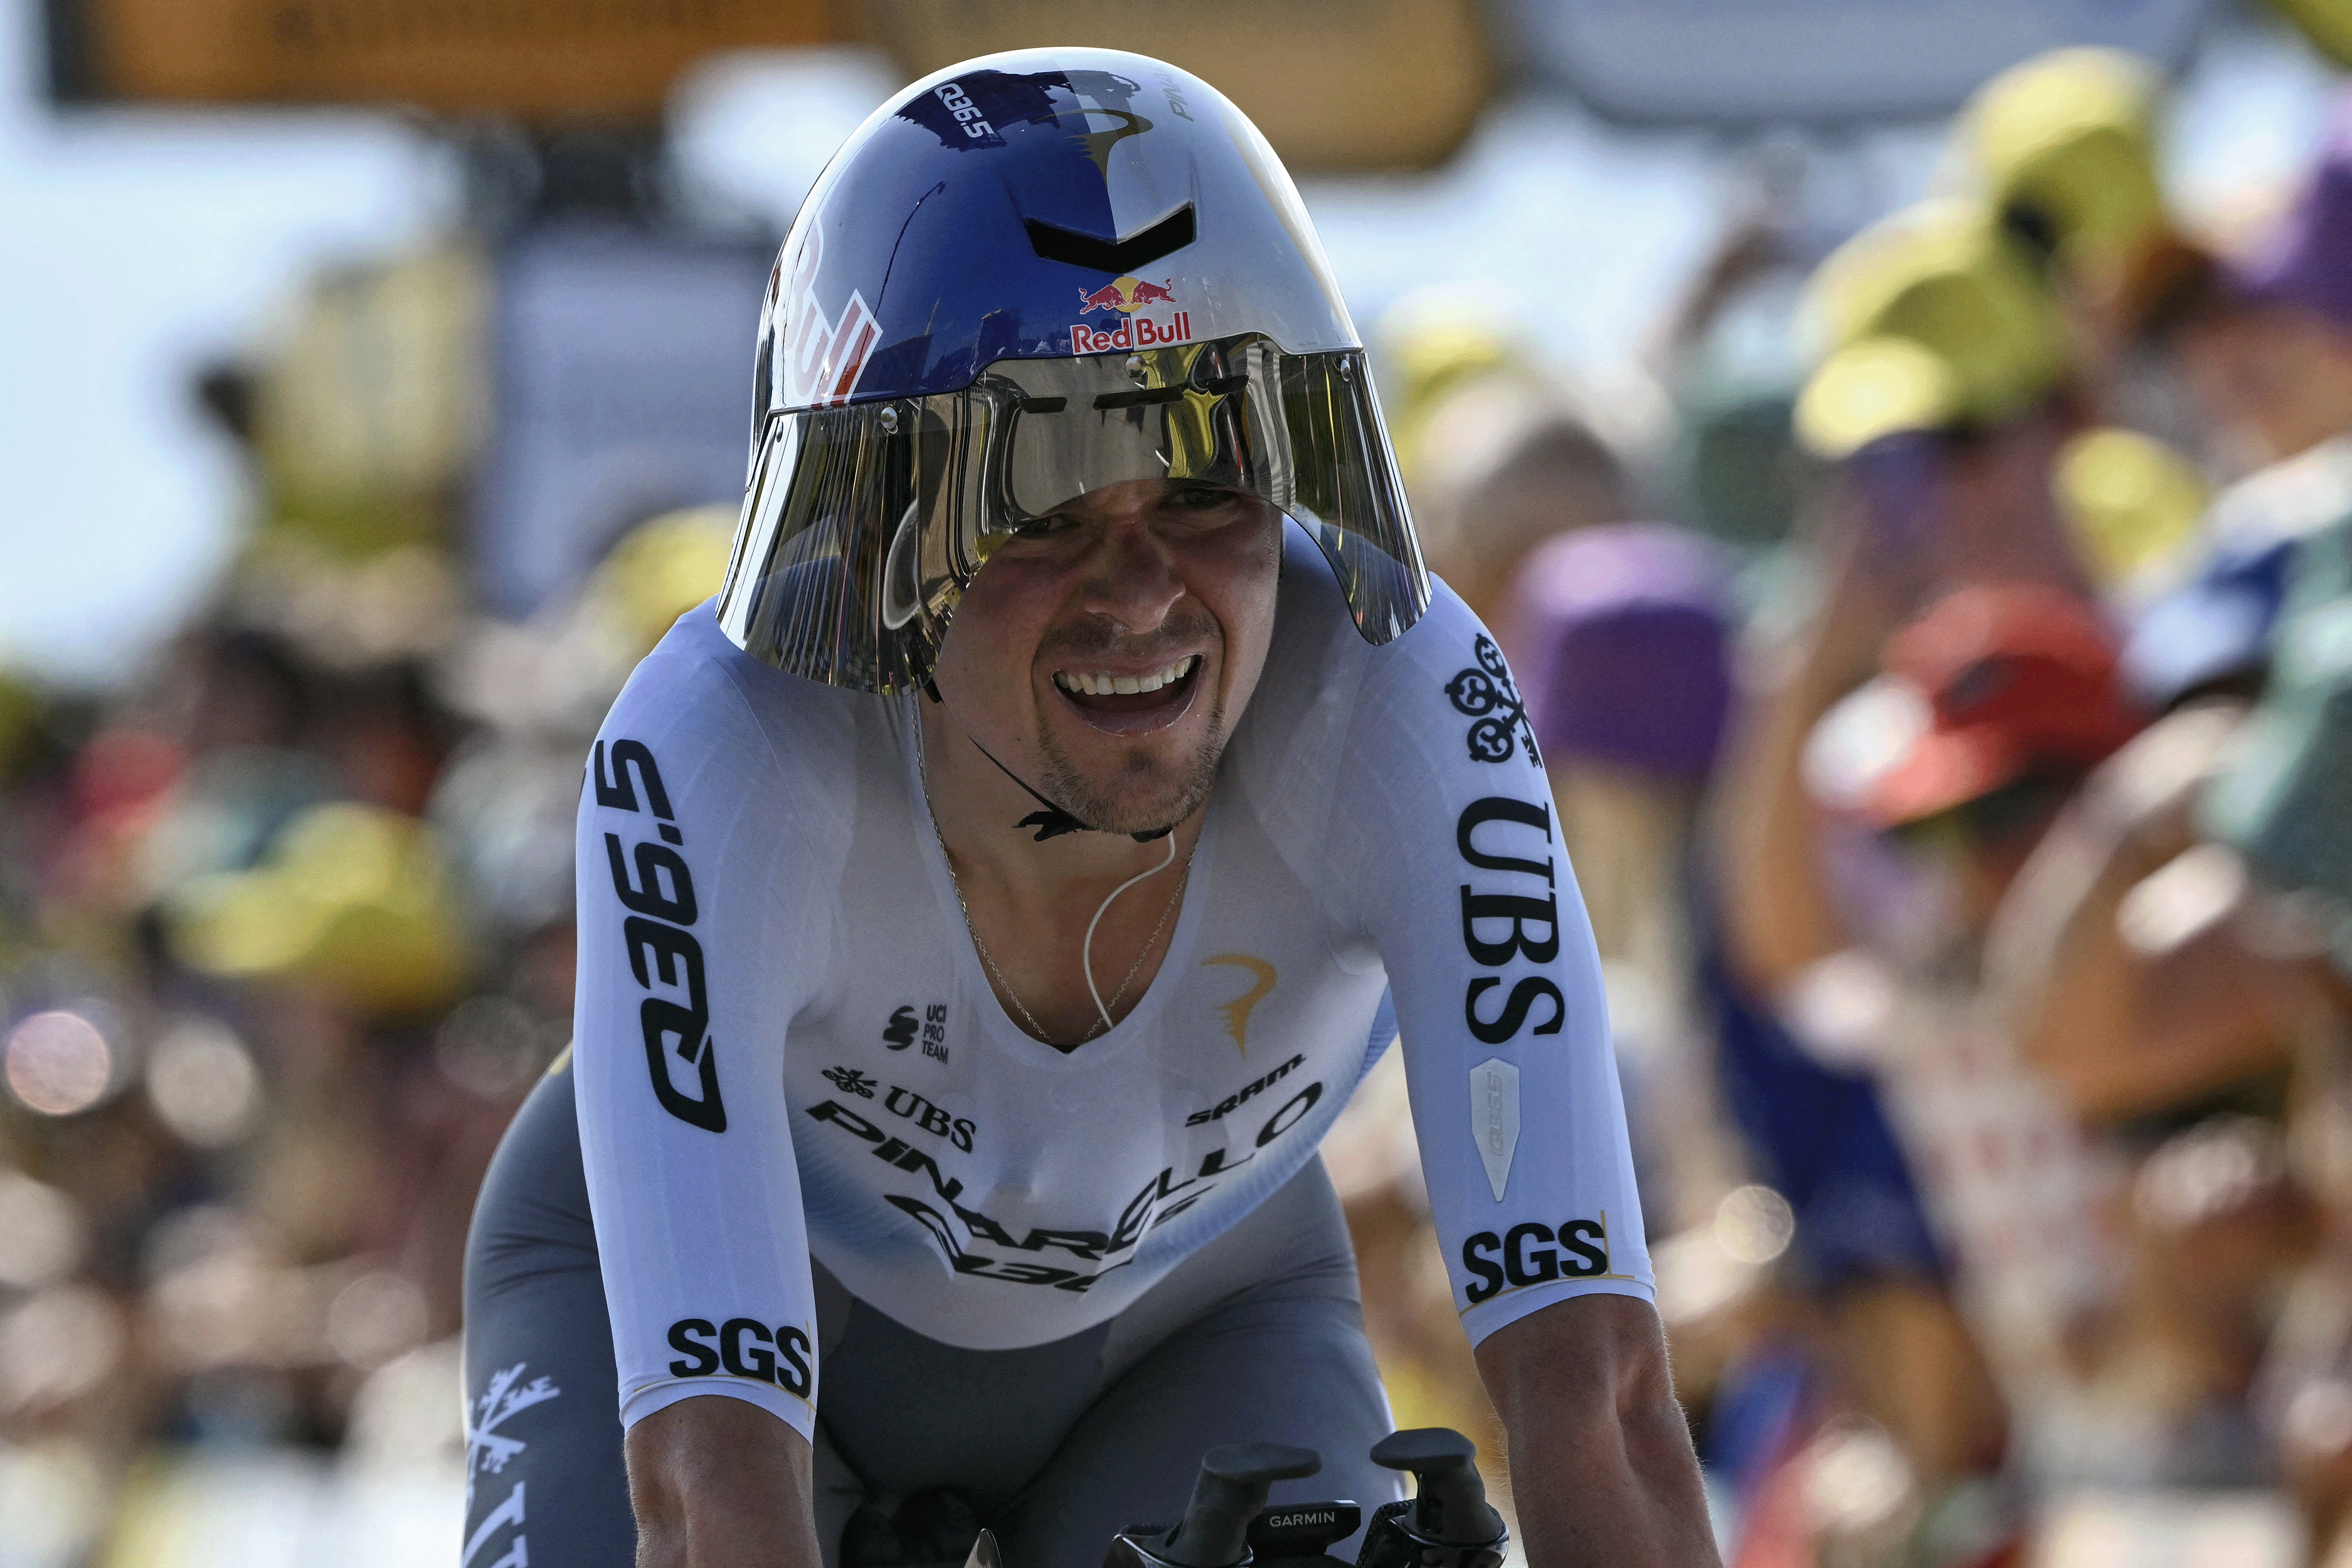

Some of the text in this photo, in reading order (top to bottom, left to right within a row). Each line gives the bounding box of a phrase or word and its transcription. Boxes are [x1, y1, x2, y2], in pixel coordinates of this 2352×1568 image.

[935, 83, 994, 137] Q36.5
[1070, 312, 1191, 354] Red Bull
[595, 739, 727, 1133] Q36.5
[1456, 797, 1565, 1045] UBS
[923, 1023, 945, 1042] PRO
[926, 1005, 947, 1023] UCI
[922, 1040, 949, 1065] TEAM
[884, 1086, 976, 1153] UBS
[1185, 1054, 1307, 1127] SRAM
[805, 1100, 1323, 1261] PINARELLO
[1462, 1219, 1608, 1305] SGS
[667, 1318, 811, 1399] SGS
[1269, 1512, 1335, 1527] GARMIN
